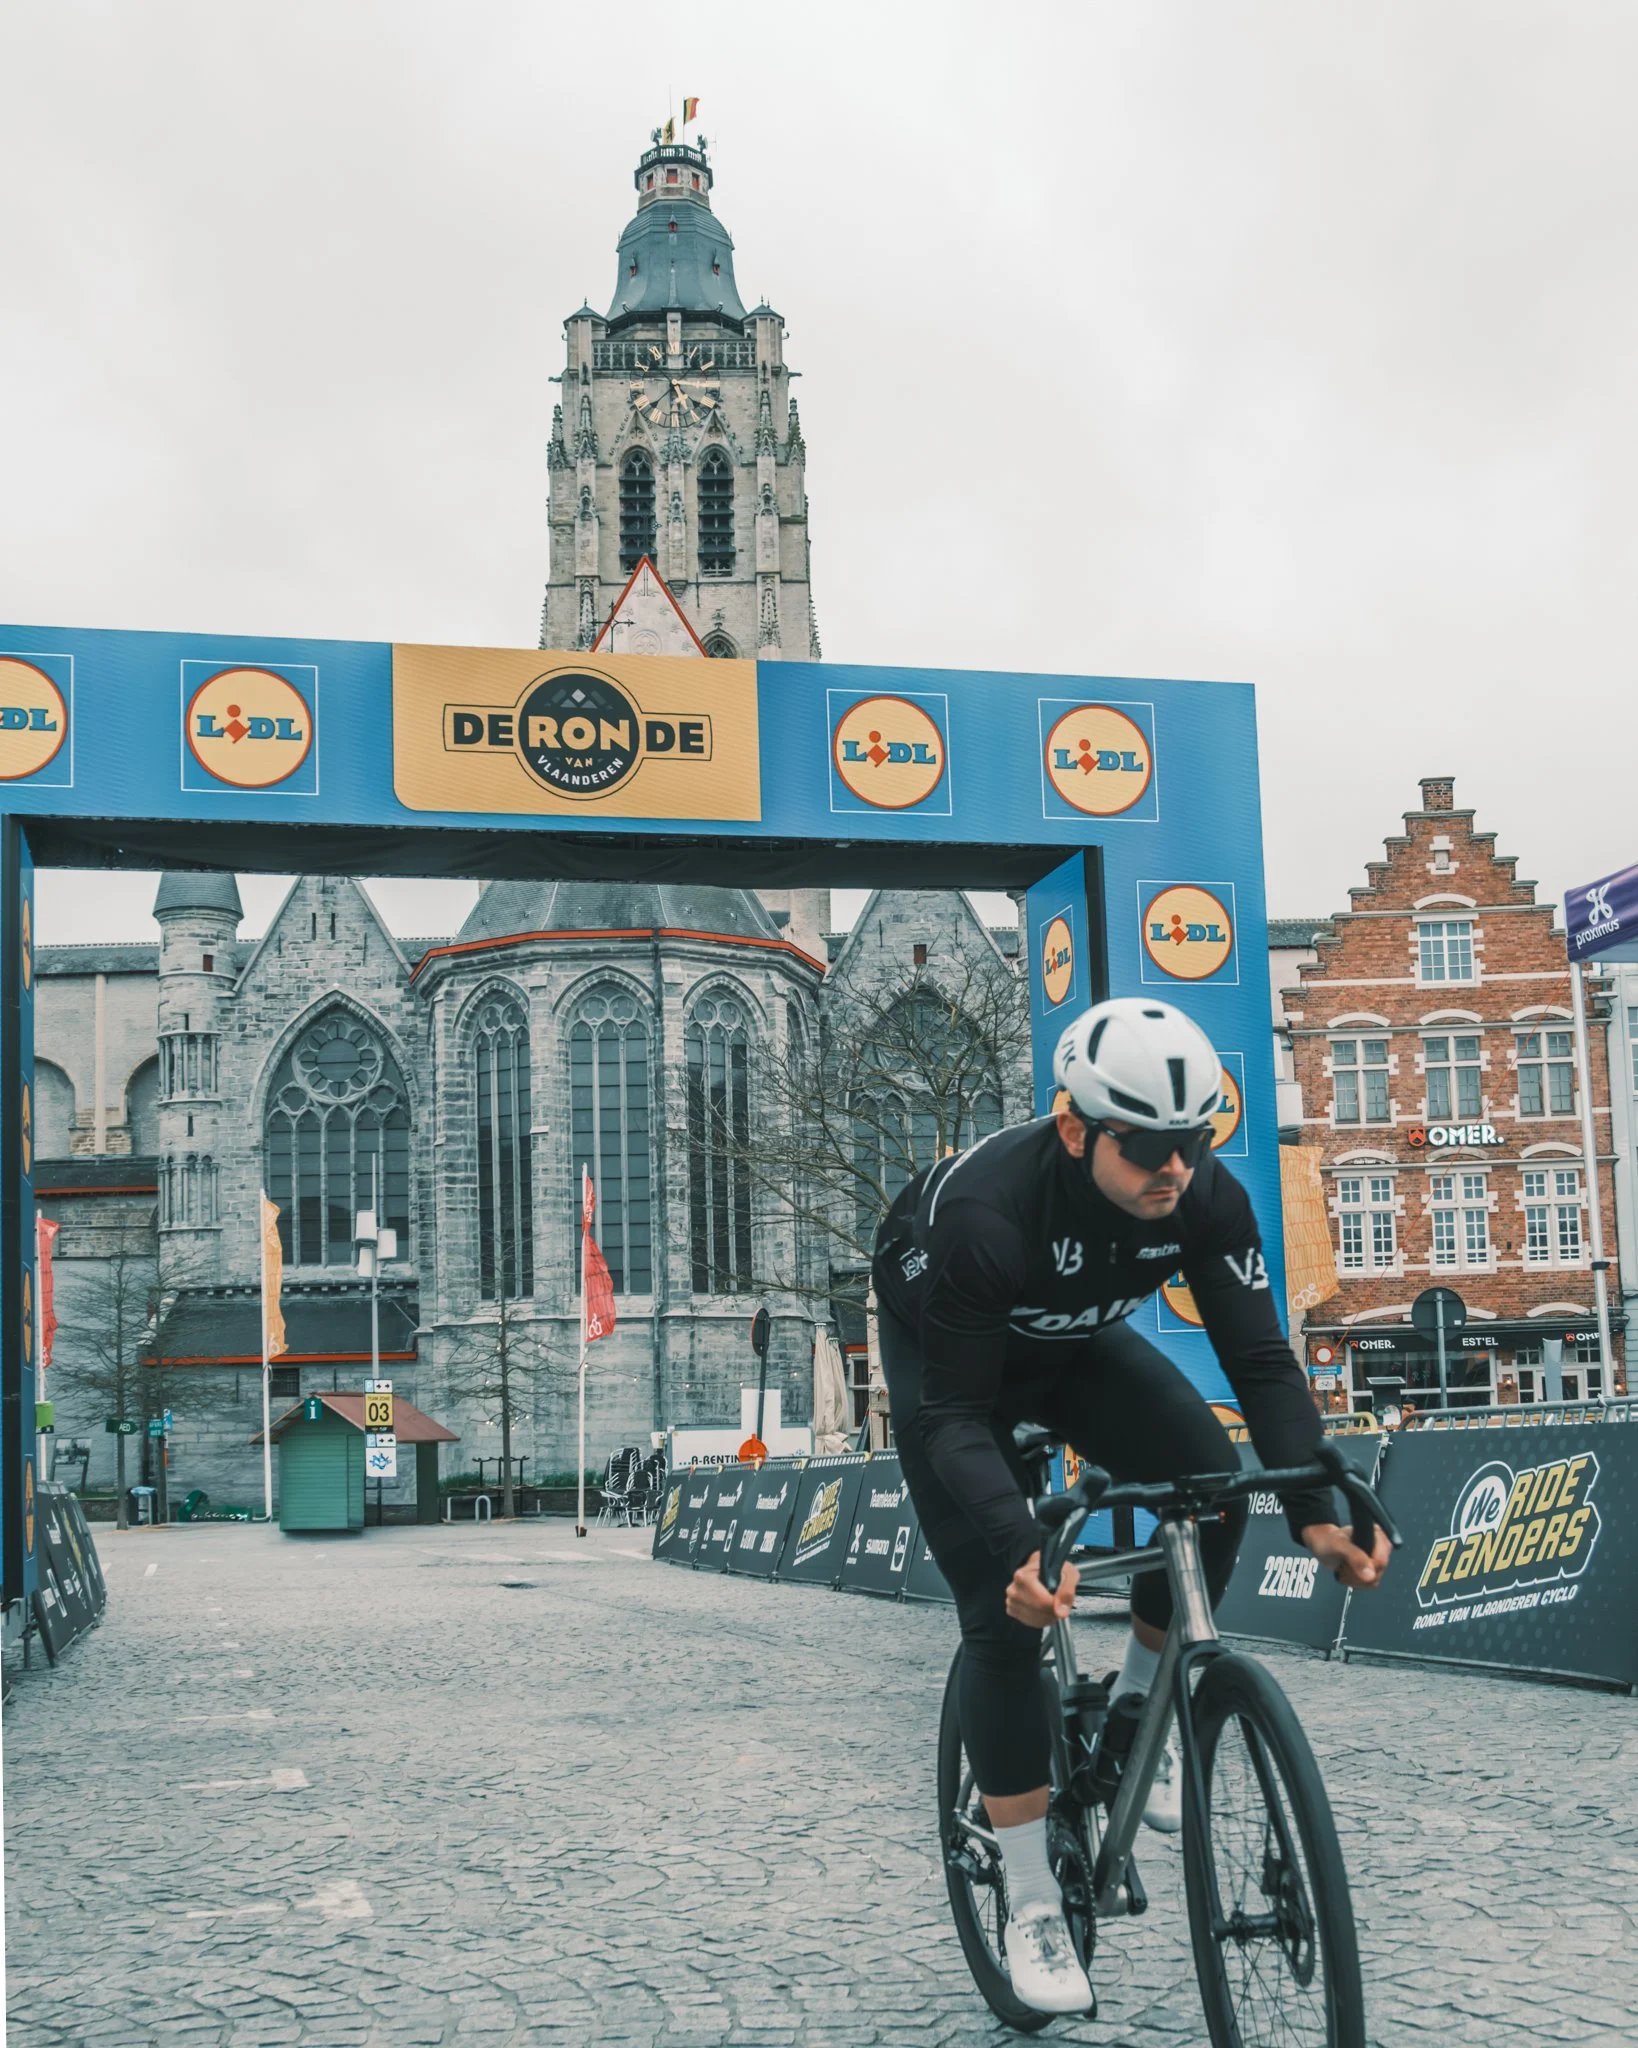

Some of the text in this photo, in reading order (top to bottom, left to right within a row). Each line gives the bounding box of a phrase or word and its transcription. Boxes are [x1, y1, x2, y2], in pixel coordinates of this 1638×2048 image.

[0, 707, 57, 732] DL
[453, 712, 514, 746] DE
[537, 755, 624, 785] VLAANDEREN
[565, 757, 593, 768] VAN
[1576, 918, 1619, 950] proximus
[1462, 1337, 1499, 1347] EST'EL
[119, 1423, 131, 1432] AED
[368, 1402, 390, 1422] 03
[1509, 1458, 1588, 1519] RIDE
[1465, 1487, 1500, 1529] We
[1258, 1556, 1319, 1599] 226ERS
[1413, 1584, 1579, 1630] RONDE VAN VLAANDEREN CYCLO
